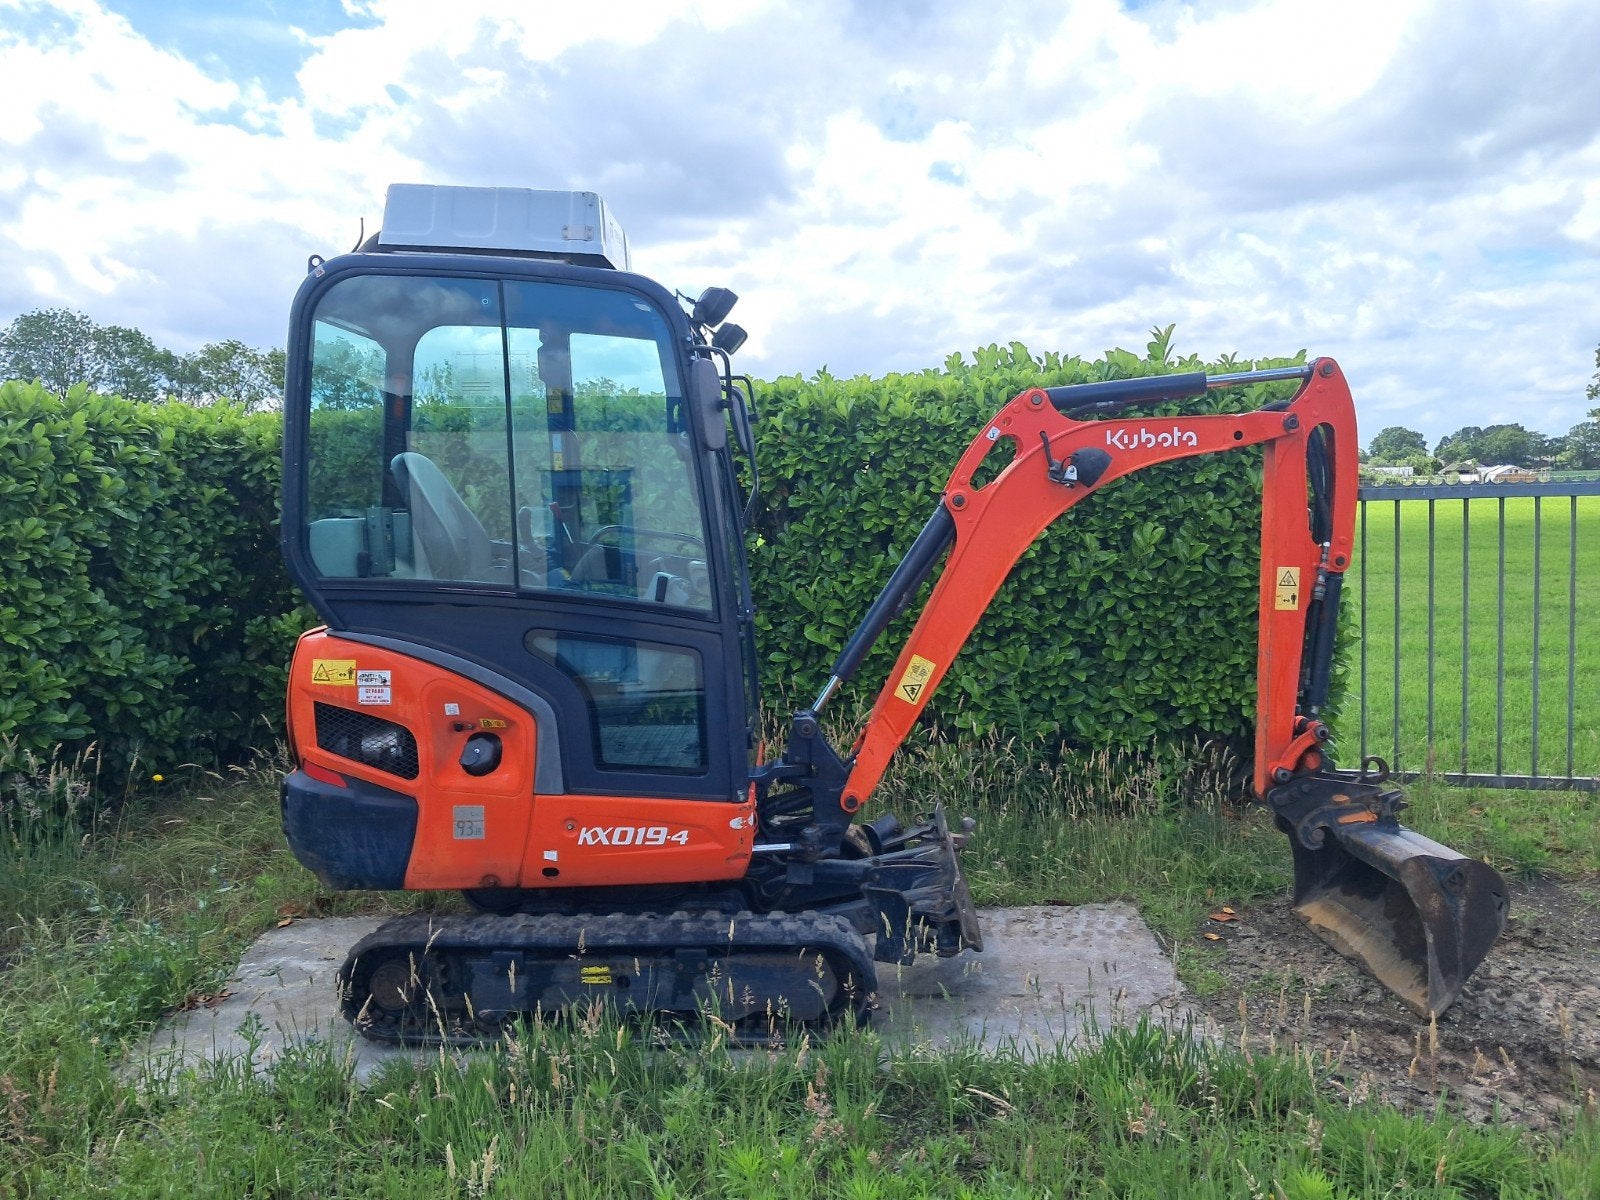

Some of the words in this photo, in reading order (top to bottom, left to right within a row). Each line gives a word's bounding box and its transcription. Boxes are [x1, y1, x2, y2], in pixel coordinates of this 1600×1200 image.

[1106, 426, 1198, 450] Kubota
[457, 820, 473, 836] 93
[577, 826, 690, 846] KX019-4
